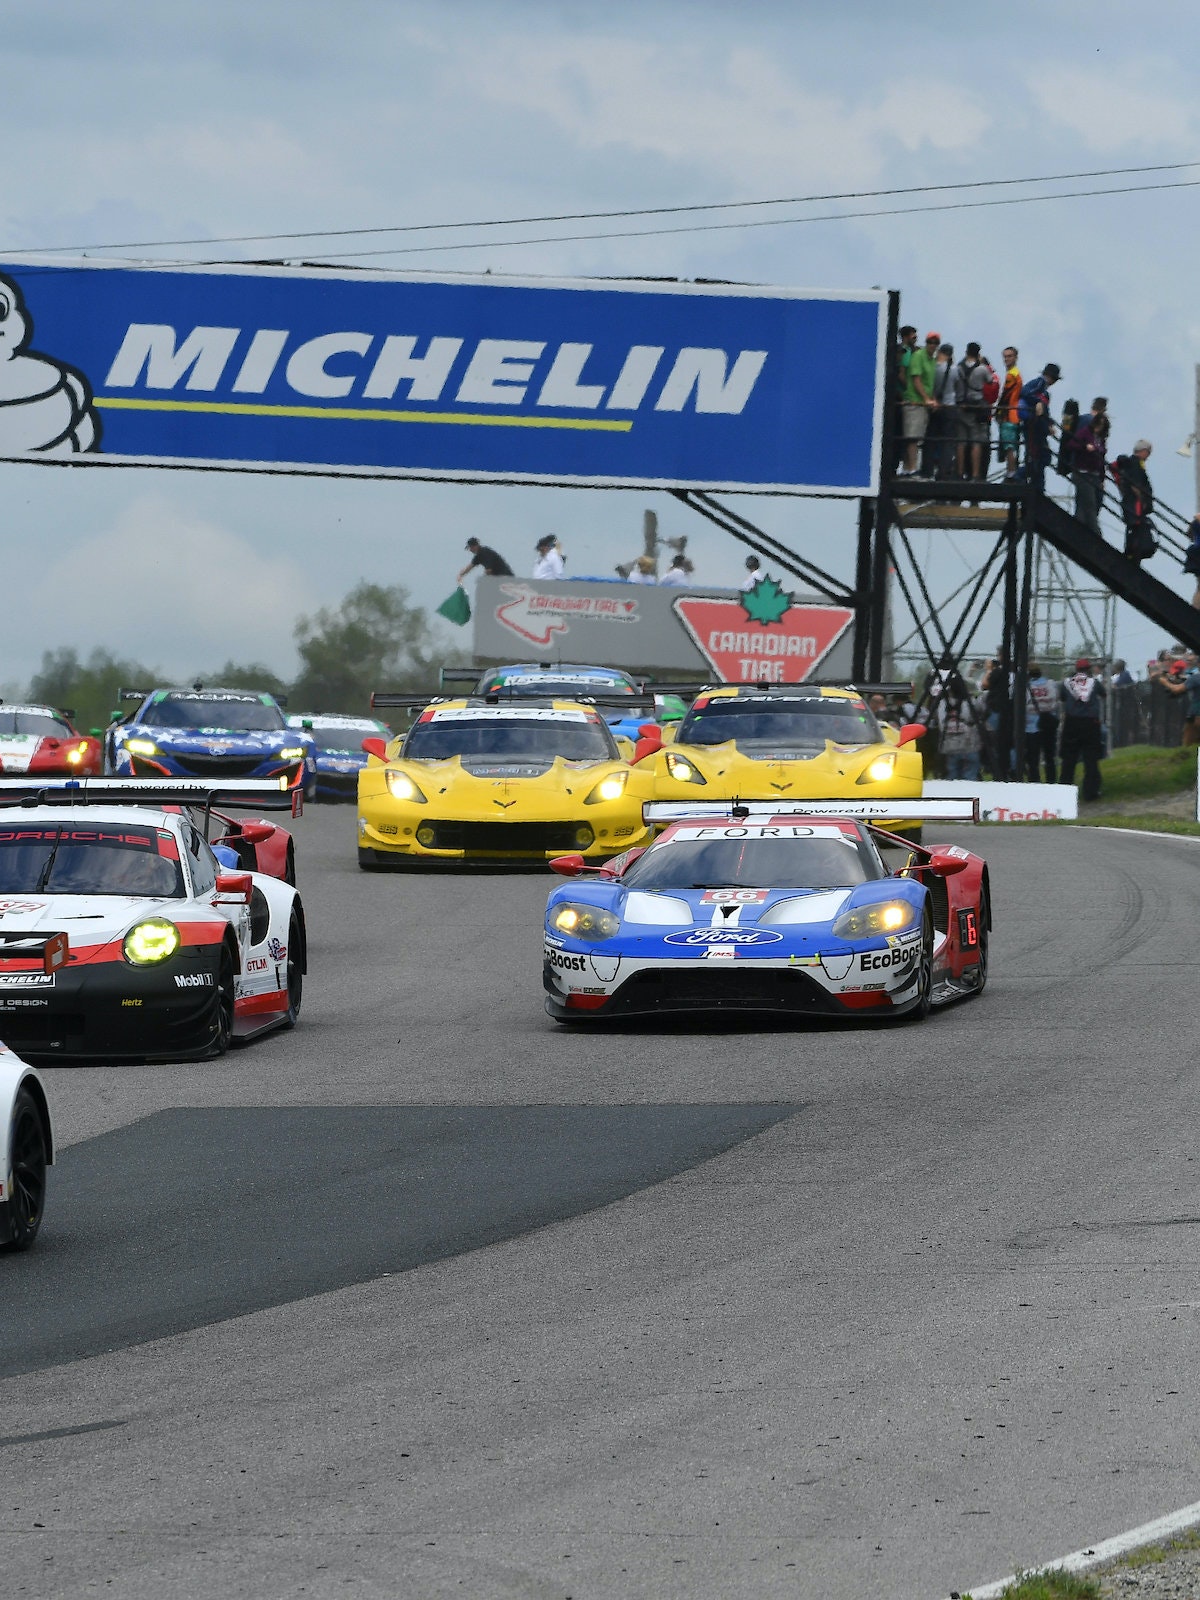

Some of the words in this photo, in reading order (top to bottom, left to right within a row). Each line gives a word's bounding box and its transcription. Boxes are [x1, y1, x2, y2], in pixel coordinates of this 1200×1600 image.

[103, 322, 768, 414] MICHELIN
[709, 631, 817, 657] CANADIAN
[739, 659, 785, 683] TIRE
[186, 693, 257, 702] ACURA
[437, 710, 583, 718] CORVETTE
[696, 827, 815, 838] FORD
[711, 891, 758, 900] 66
[686, 929, 761, 944] Ford
[860, 940, 922, 972] EcoBoos
[246, 958, 268, 972] GTLM
[174, 973, 205, 988] Mobil
[7, 999, 48, 1007] DESIGN
[121, 999, 143, 1007] Hertz
